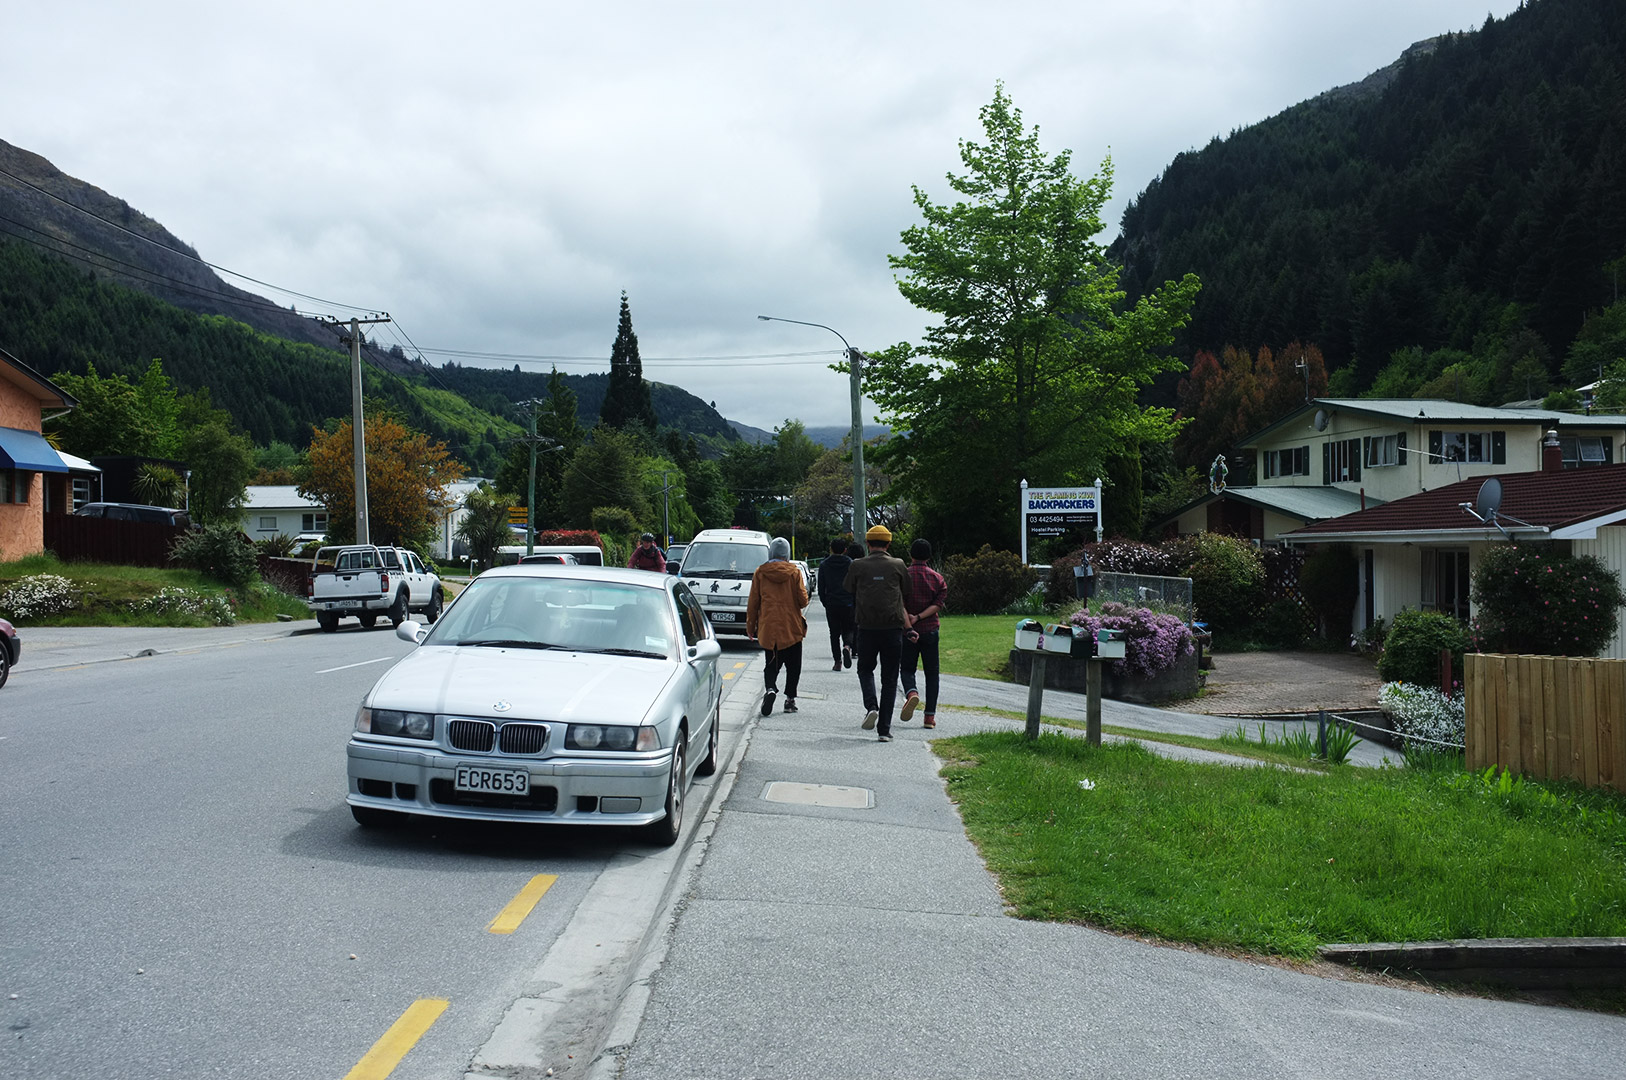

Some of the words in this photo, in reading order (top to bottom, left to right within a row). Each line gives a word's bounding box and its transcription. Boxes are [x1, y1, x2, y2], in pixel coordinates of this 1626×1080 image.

[1028, 491, 1044, 500] THE
[1028, 499, 1095, 510] BACKPACKERS
[1038, 515, 1064, 523] 4425494
[457, 769, 527, 792] ECR653
